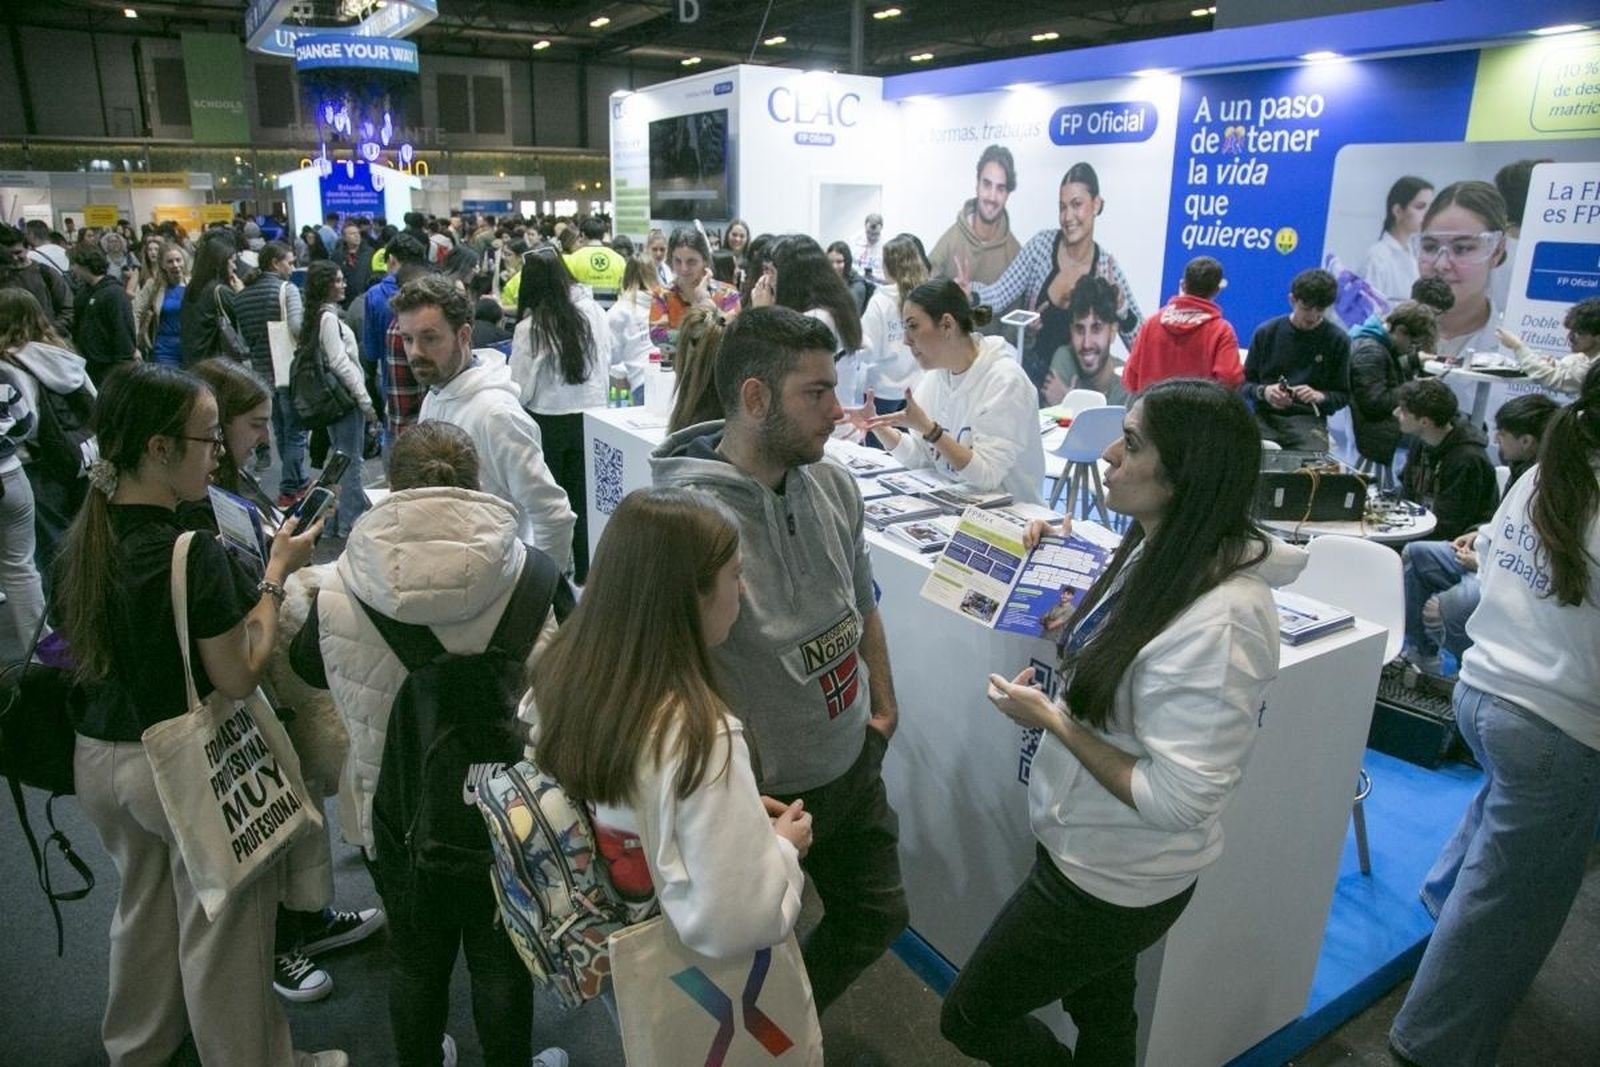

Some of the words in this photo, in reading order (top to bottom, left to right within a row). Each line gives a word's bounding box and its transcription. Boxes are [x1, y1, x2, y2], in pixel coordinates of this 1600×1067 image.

[679, 0, 700, 23] D
[296, 44, 342, 62] CHANGE
[343, 43, 390, 60] YOUR
[1553, 84, 1571, 97] de
[767, 86, 861, 127] CEAC
[1193, 96, 1213, 123] A
[1219, 99, 1252, 122] un
[1258, 94, 1325, 127] paso
[1060, 113, 1083, 136] FP
[1087, 108, 1145, 134] Oficial
[1190, 126, 1220, 154] de
[1247, 125, 1320, 153] tener
[1187, 157, 1209, 185] la
[1216, 157, 1269, 186] vida
[1548, 181, 1574, 201] La
[1184, 193, 1230, 222] que
[1542, 208, 1568, 224] es
[1573, 205, 1600, 225] FP
[1181, 219, 1273, 250] quieres
[1556, 276, 1569, 286] FP
[1570, 277, 1598, 288] Oficial
[1520, 313, 1560, 330] Doble
[467, 762, 507, 787] NIKE
[221, 757, 285, 835] MUY
